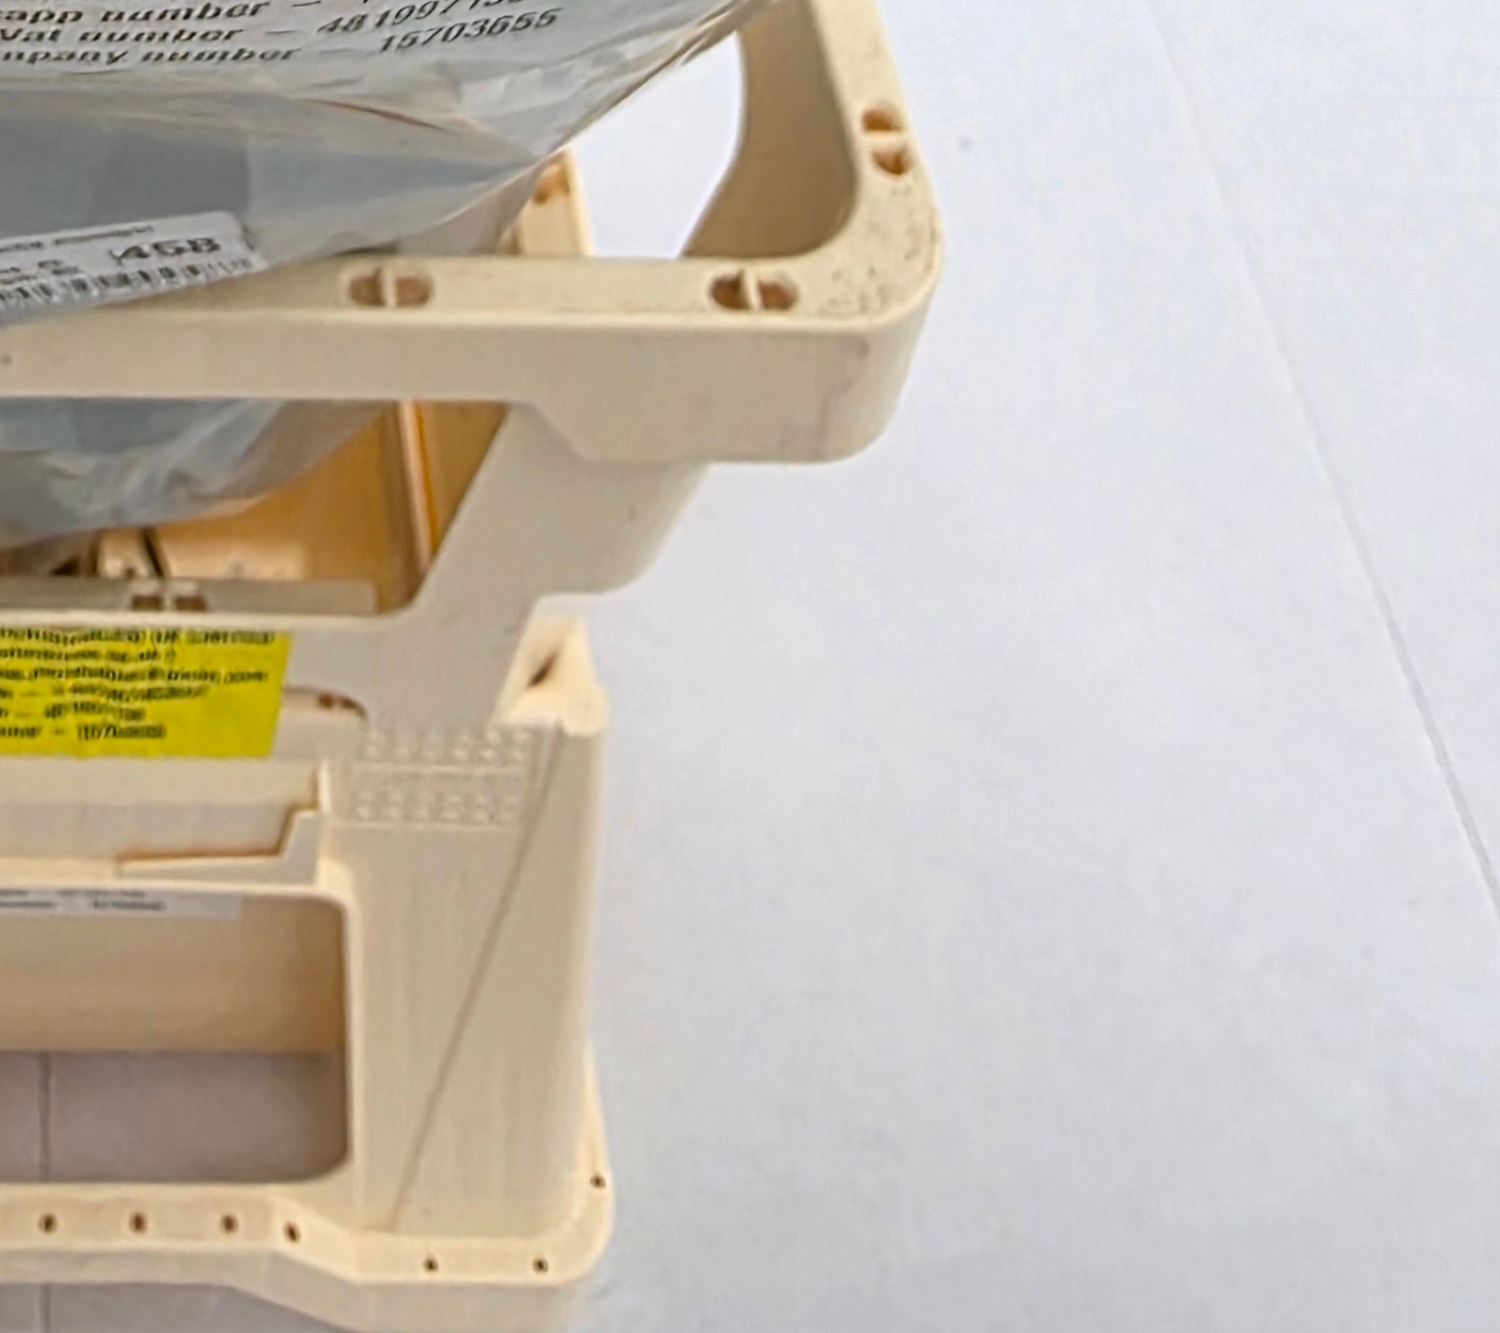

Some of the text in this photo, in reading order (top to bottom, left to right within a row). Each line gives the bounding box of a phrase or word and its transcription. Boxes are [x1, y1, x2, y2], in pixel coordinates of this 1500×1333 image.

[101, 1, 271, 24] number
[0, 28, 63, 43] Vat
[78, 28, 245, 44] number
[140, 47, 301, 63] number
